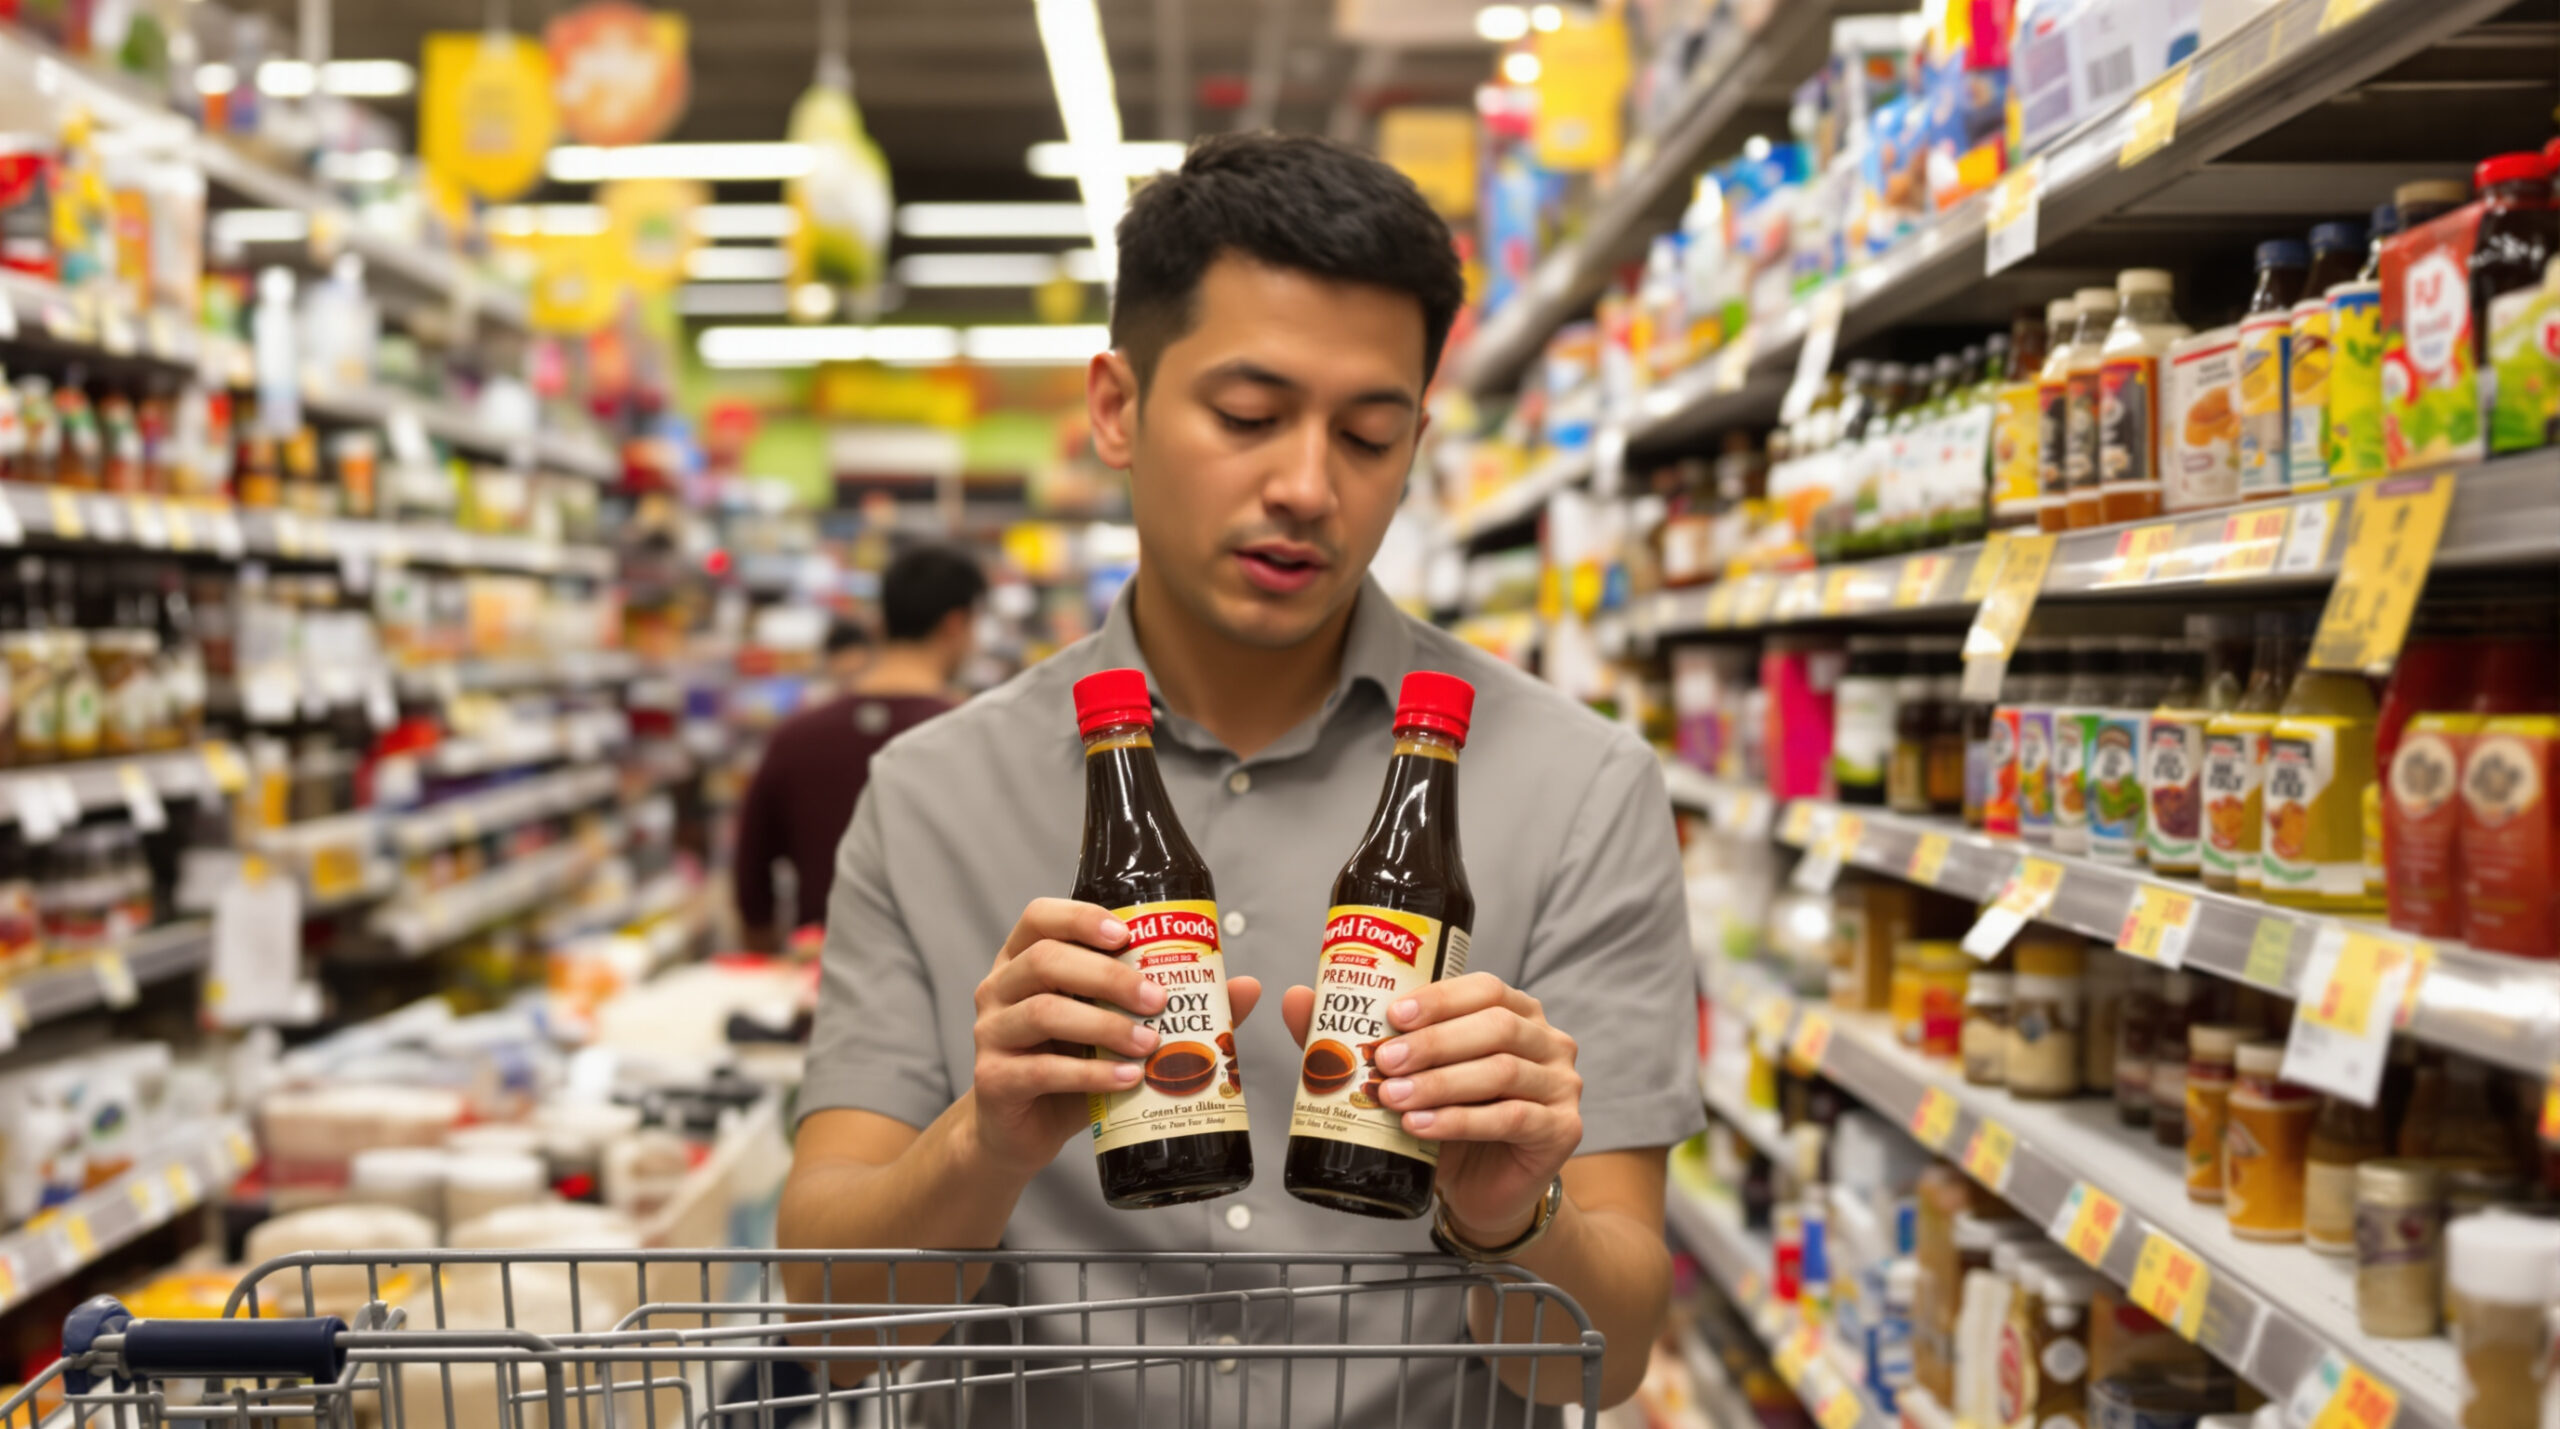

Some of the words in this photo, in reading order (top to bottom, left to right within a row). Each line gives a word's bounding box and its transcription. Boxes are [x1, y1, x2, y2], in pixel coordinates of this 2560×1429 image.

[1130, 917, 1158, 943] rld
[1160, 914, 1215, 939] Foods
[1356, 917, 1415, 955] Foods
[1144, 968, 1216, 987] REMIUM
[1166, 993, 1208, 1014] OYY
[1322, 993, 1376, 1016] FOYY
[1316, 1013, 1383, 1038] SAUCE
